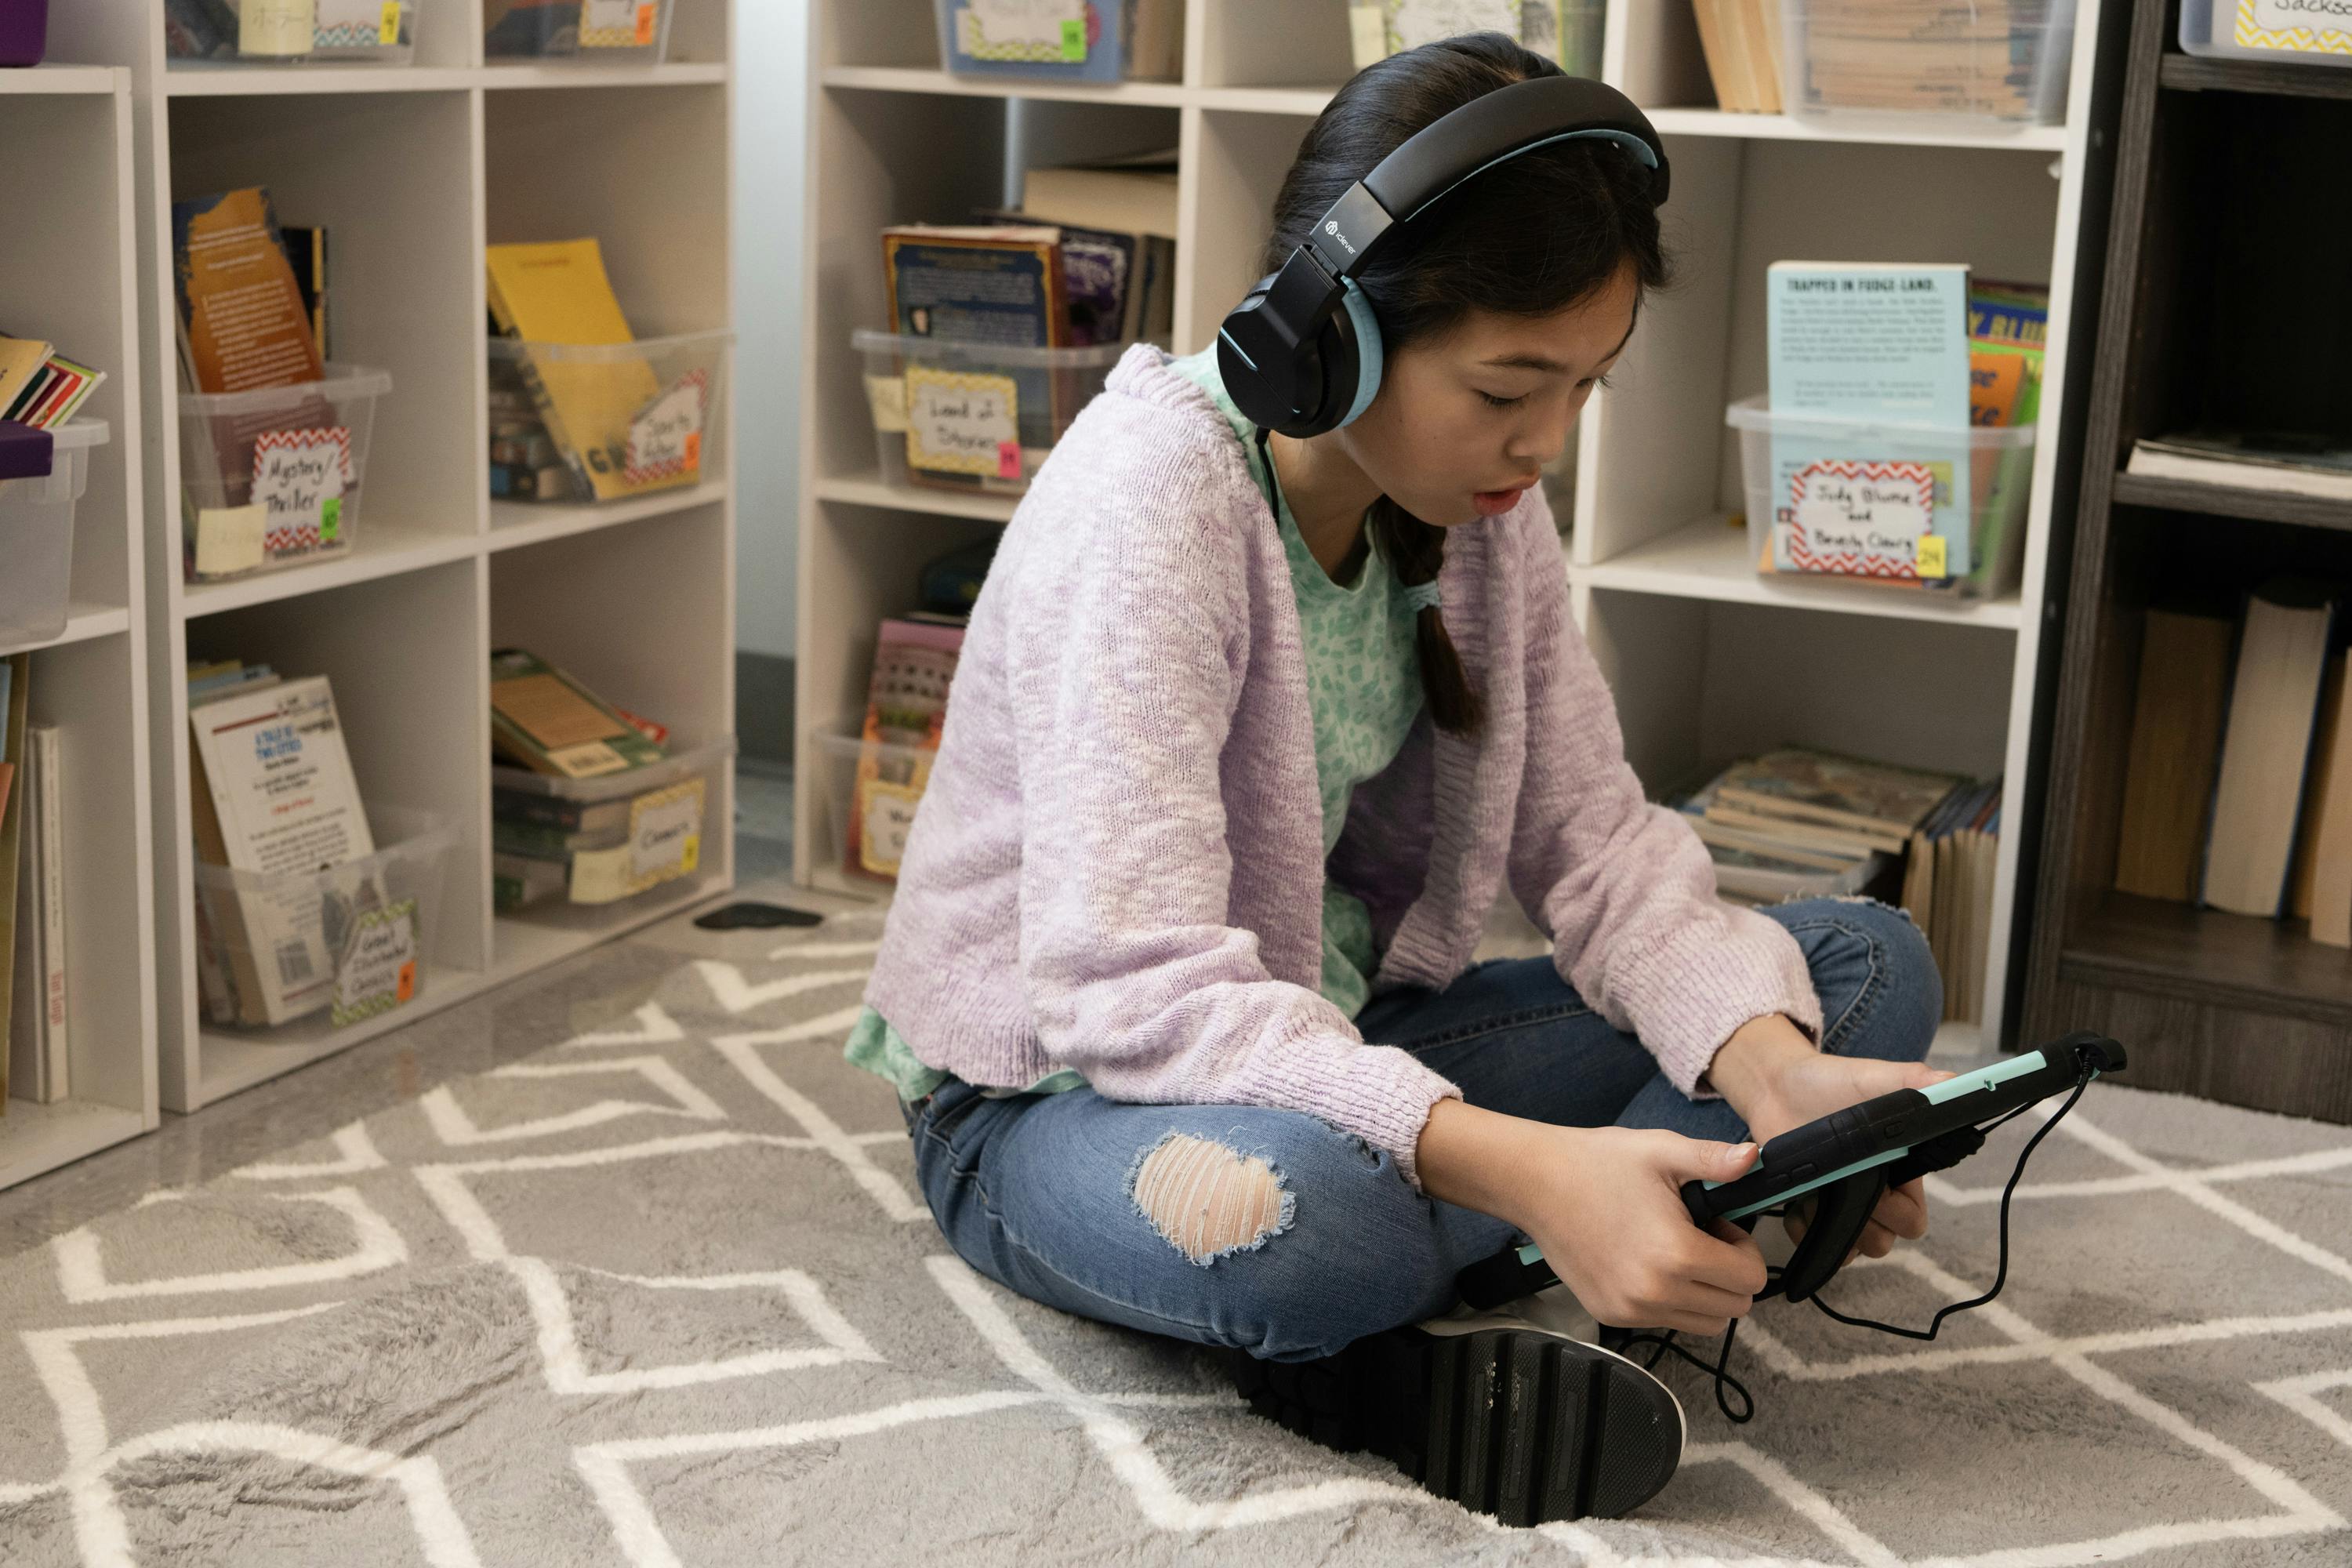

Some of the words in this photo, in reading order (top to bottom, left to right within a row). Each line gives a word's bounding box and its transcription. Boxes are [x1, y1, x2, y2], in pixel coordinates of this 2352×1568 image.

[1787, 278, 1836, 292] TRAPPED
[1841, 278, 1853, 292] IN
[1857, 278, 1894, 292] FUDGE
[930, 398, 968, 419] Land
[265, 488, 318, 513] Thriller
[1818, 484, 1853, 511] Judy
[1861, 487, 1911, 504] Blume
[1848, 510, 1872, 523] and
[1815, 528, 1864, 552] Beverly
[1867, 531, 1913, 552] Cleary
